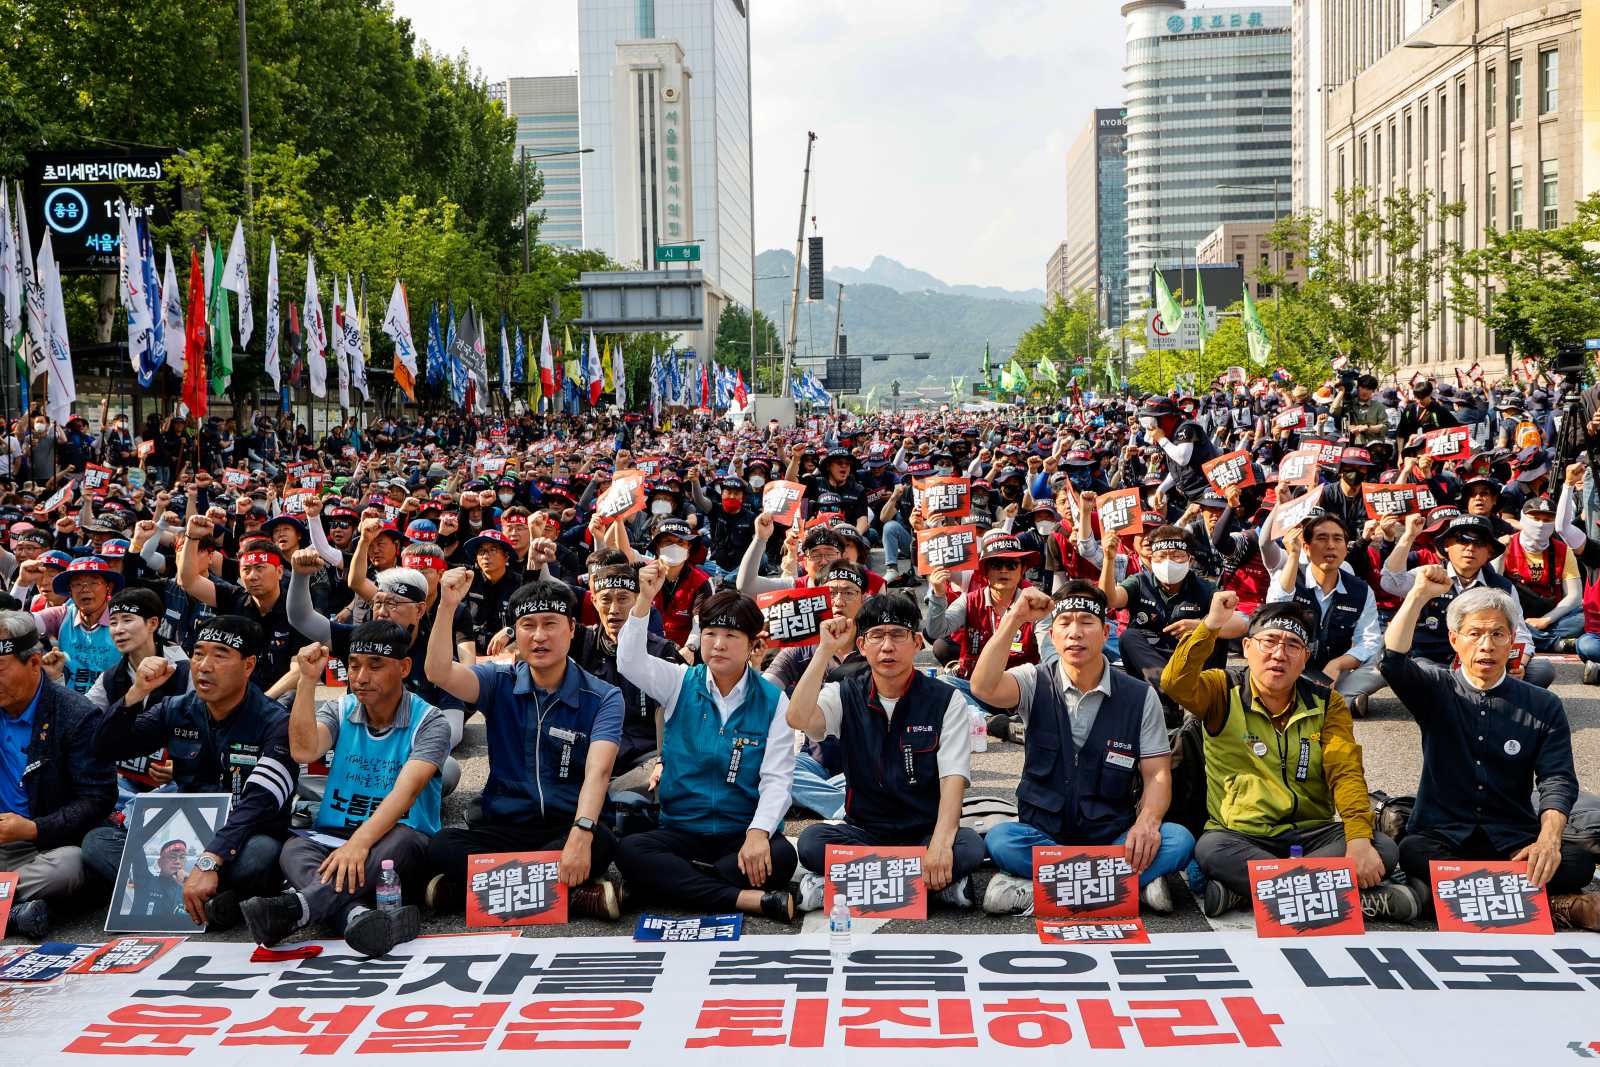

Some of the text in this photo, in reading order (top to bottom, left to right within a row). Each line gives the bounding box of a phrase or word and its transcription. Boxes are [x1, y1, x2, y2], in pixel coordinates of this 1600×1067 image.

[54, 203, 79, 218] 좋음
[951, 531, 973, 545] 정권
[929, 545, 963, 564] 퇴진!
[797, 594, 828, 614] 정권
[769, 611, 817, 640] 퇴진!
[472, 867, 522, 892] 윤석열
[830, 857, 922, 882] 윤석열 정권
[1038, 861, 1092, 883] 윤석열
[488, 881, 545, 915] 퇴진!
[847, 877, 904, 907] 퇴진!
[1056, 876, 1115, 907] 퇴진!
[1257, 869, 1352, 900] 윤석열 정권
[1438, 877, 1495, 899] 윤석열
[1277, 890, 1339, 925] 퇴진!
[1458, 893, 1525, 922] 퇴진!
[1063, 930, 1124, 941] 퇴진!
[131, 951, 667, 999] 노동자를
[709, 949, 1253, 992] 죽음으로
[62, 996, 1285, 1056] 윤석열은 퇴진하라
